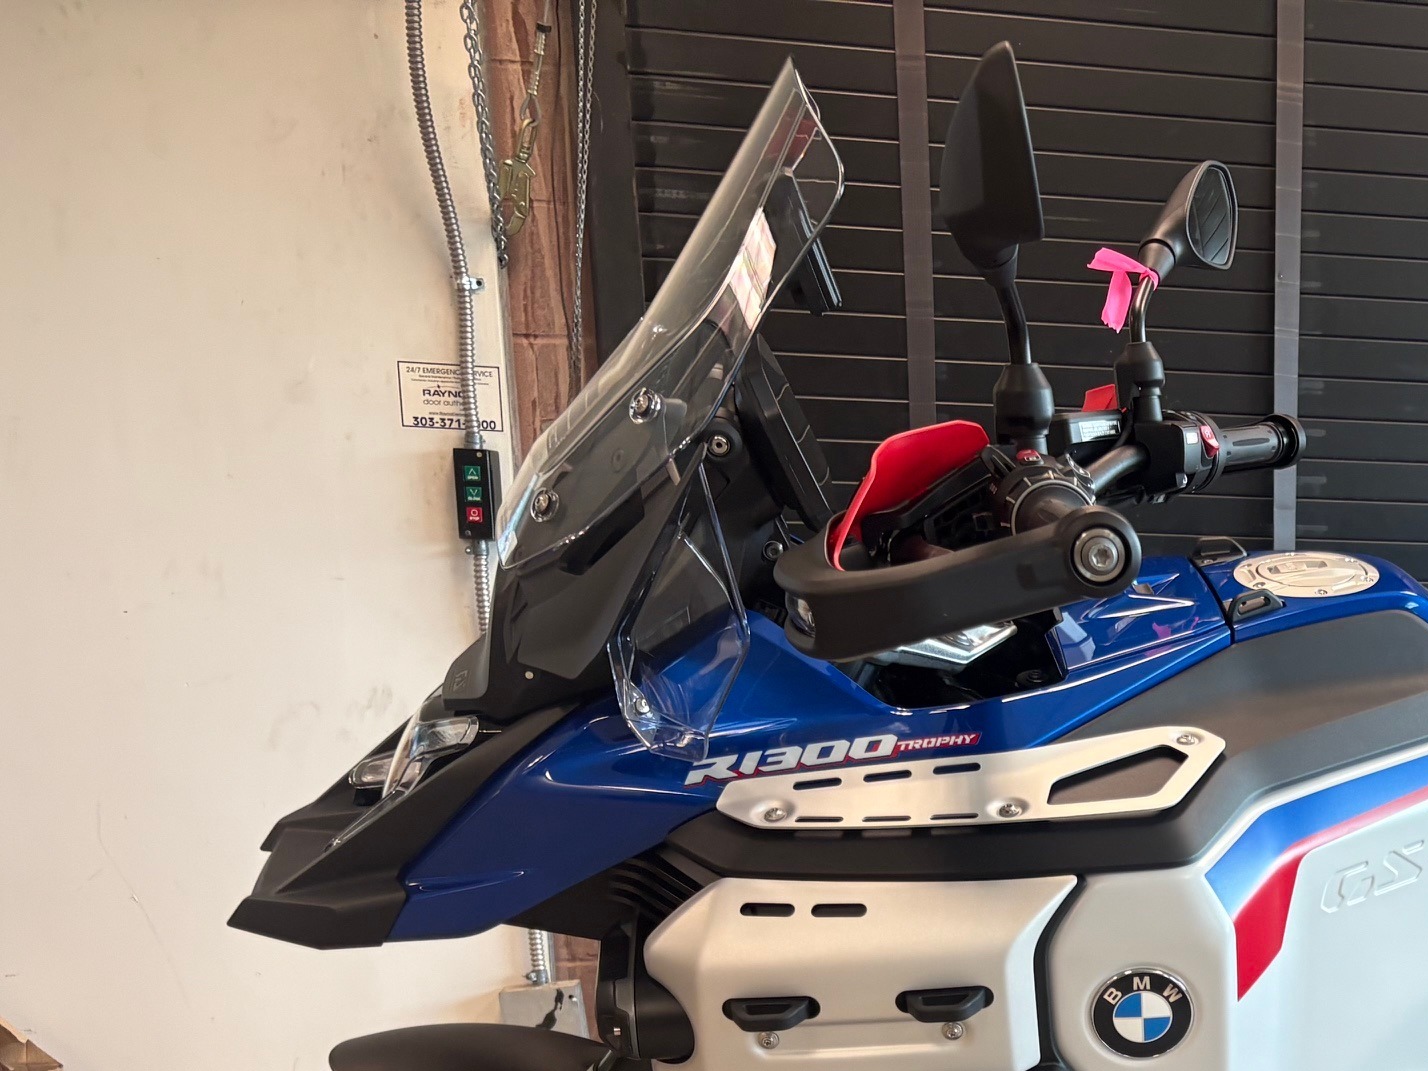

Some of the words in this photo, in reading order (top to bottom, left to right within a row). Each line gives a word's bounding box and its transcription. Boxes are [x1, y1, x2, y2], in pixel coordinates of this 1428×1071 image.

[422, 367, 462, 376] EMERGENC
[412, 416, 497, 430] 303-371-00
[684, 733, 899, 787] R1300
[897, 732, 979, 751] TROPHY
[1320, 839, 1425, 914] GS
[1102, 975, 1183, 1005] BMW
